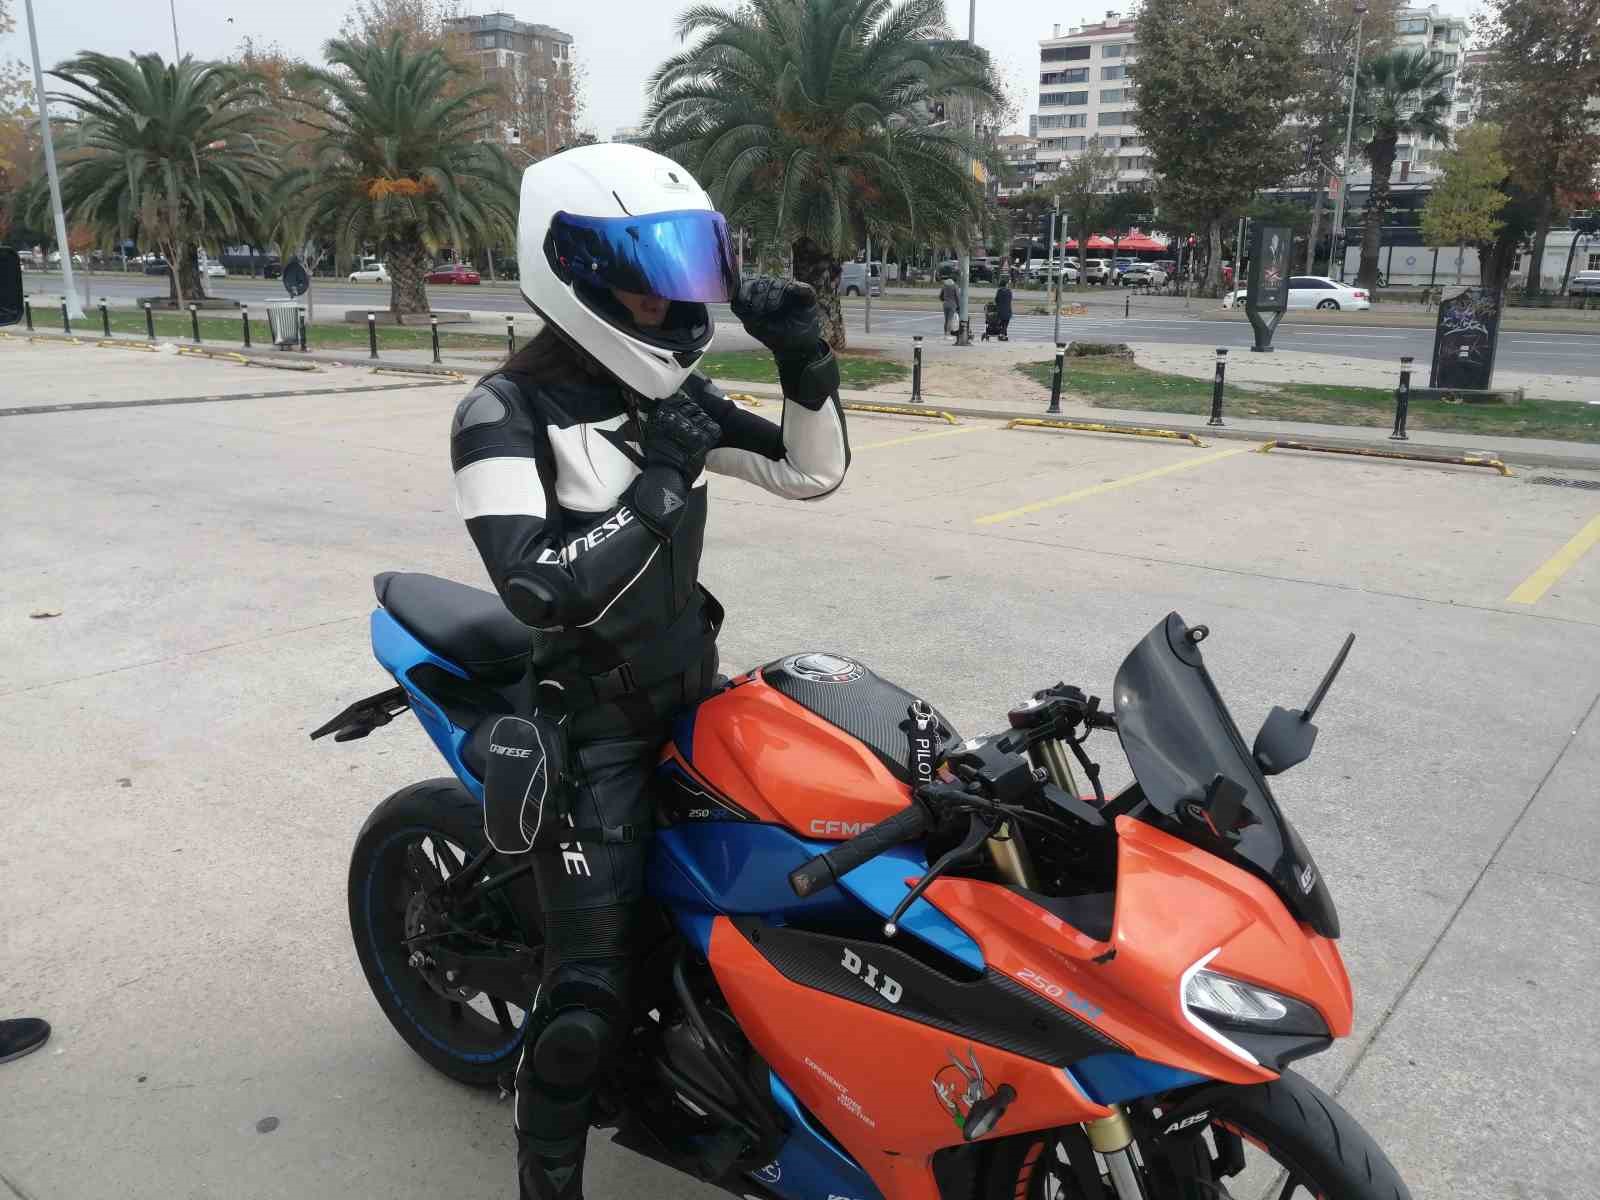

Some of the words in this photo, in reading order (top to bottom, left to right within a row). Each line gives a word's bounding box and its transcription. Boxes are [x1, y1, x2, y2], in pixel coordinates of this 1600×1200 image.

[915, 738, 932, 782] PILOT
[688, 808, 710, 819] 250
[1016, 967, 1063, 998] 250
[1163, 1109, 1210, 1135] ABS
